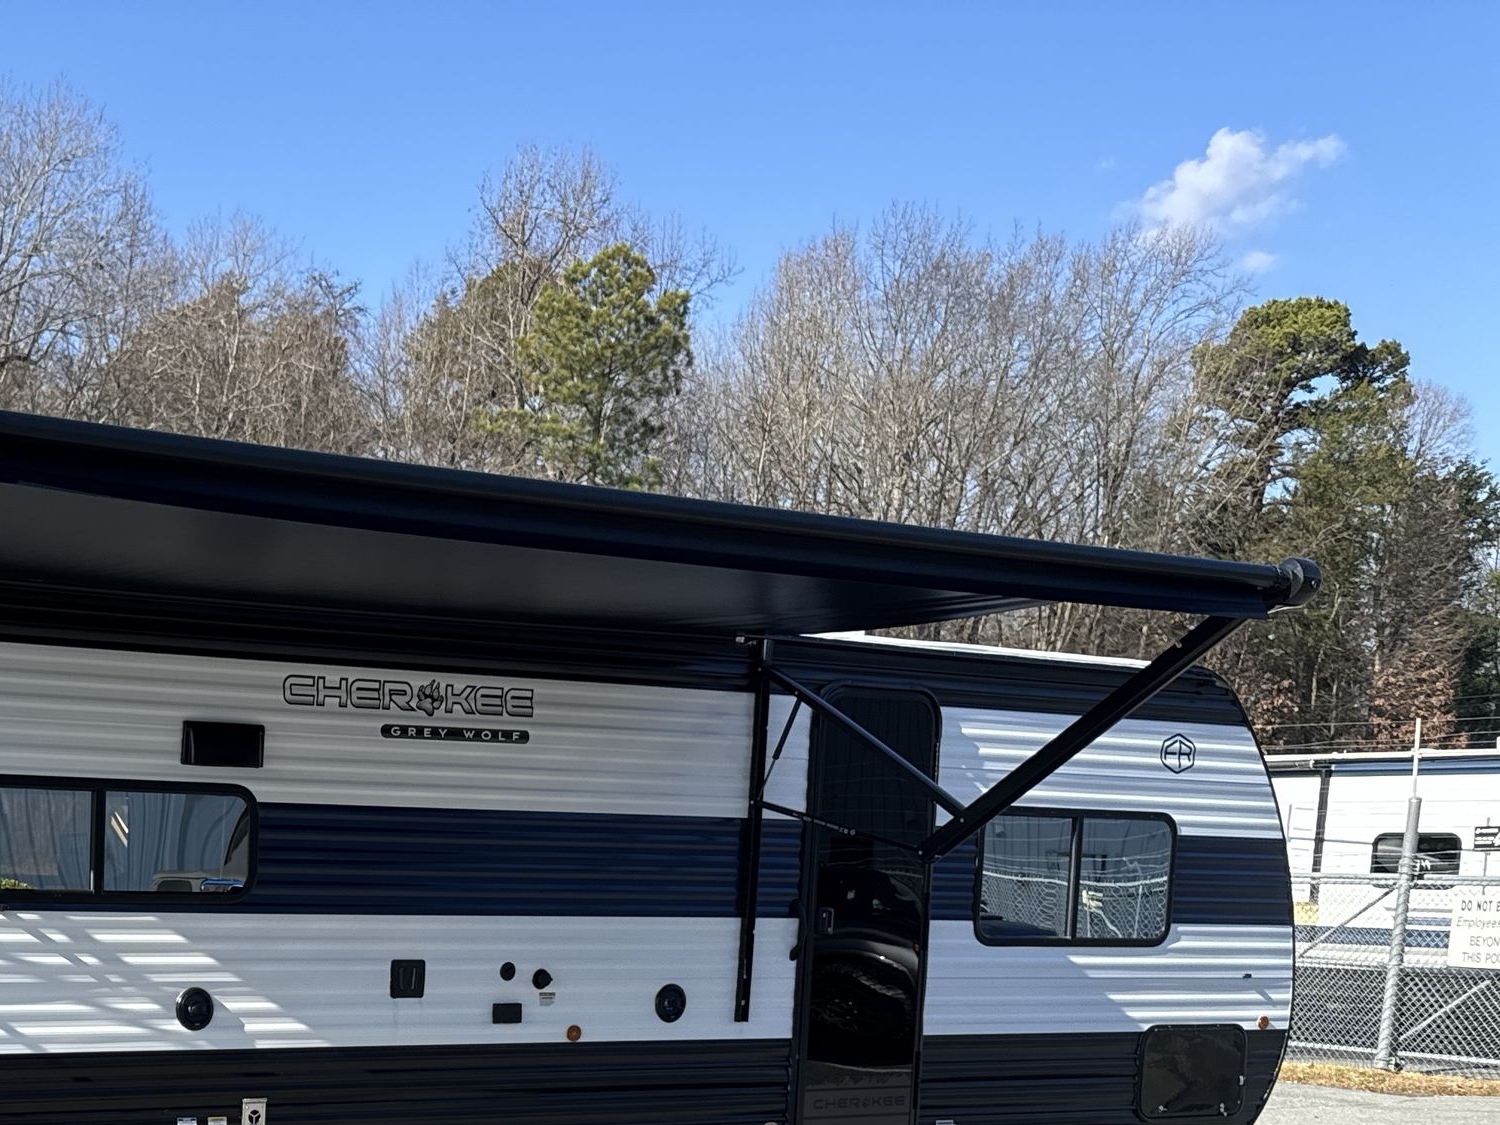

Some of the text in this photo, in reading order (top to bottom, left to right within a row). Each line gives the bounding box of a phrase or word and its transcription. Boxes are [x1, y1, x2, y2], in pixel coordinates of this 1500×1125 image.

[390, 726, 522, 742] GREY WOLF
[1461, 900, 1473, 911] DO
[1476, 900, 1493, 912] NOT
[1462, 952, 1481, 963] THIS
